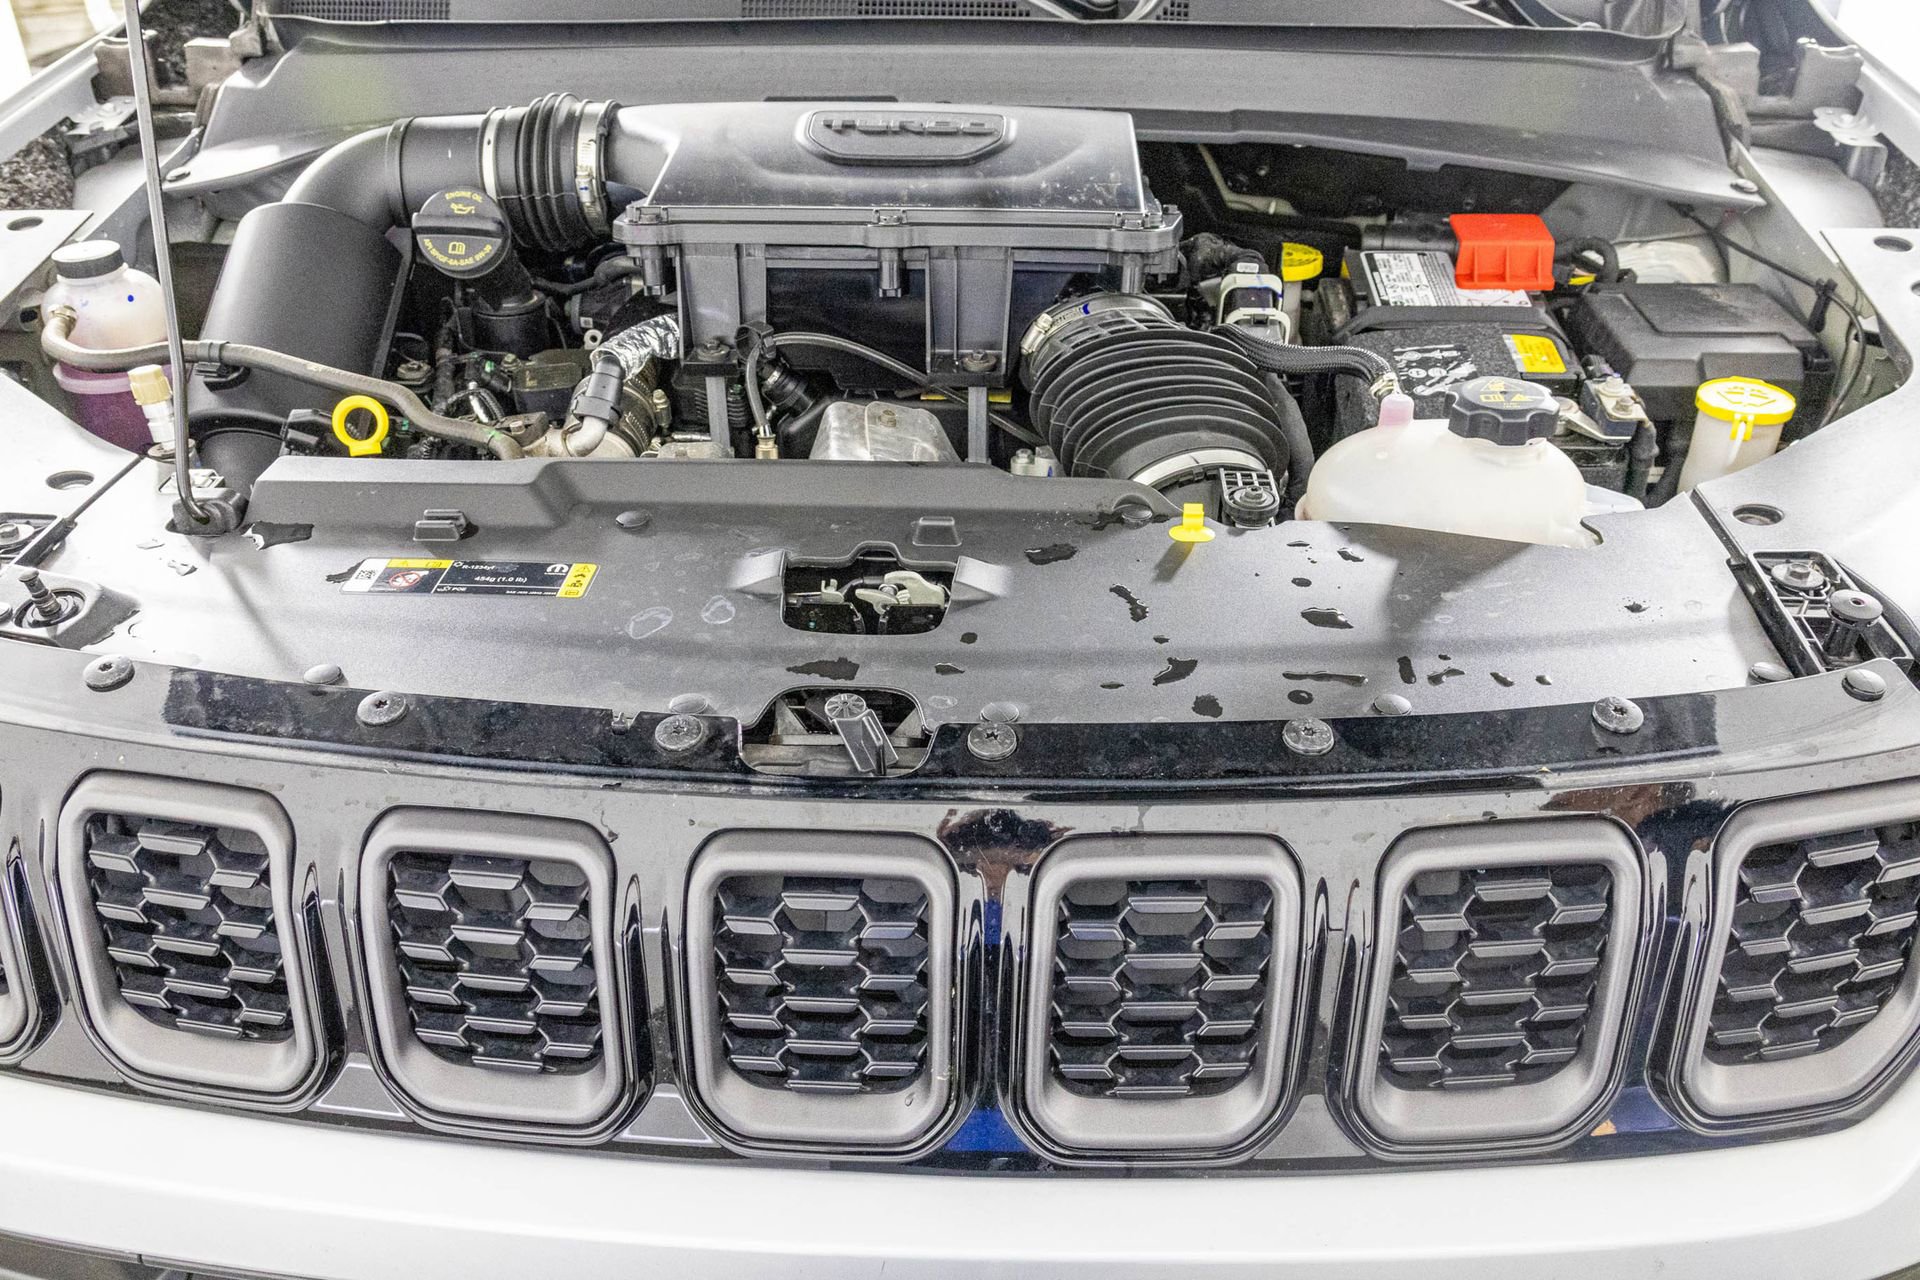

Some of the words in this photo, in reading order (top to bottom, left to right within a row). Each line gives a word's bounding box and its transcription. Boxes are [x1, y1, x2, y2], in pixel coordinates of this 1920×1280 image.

[822, 118, 997, 135] TURBO
[445, 191, 471, 200] ENGINE
[472, 194, 482, 203] OIL
